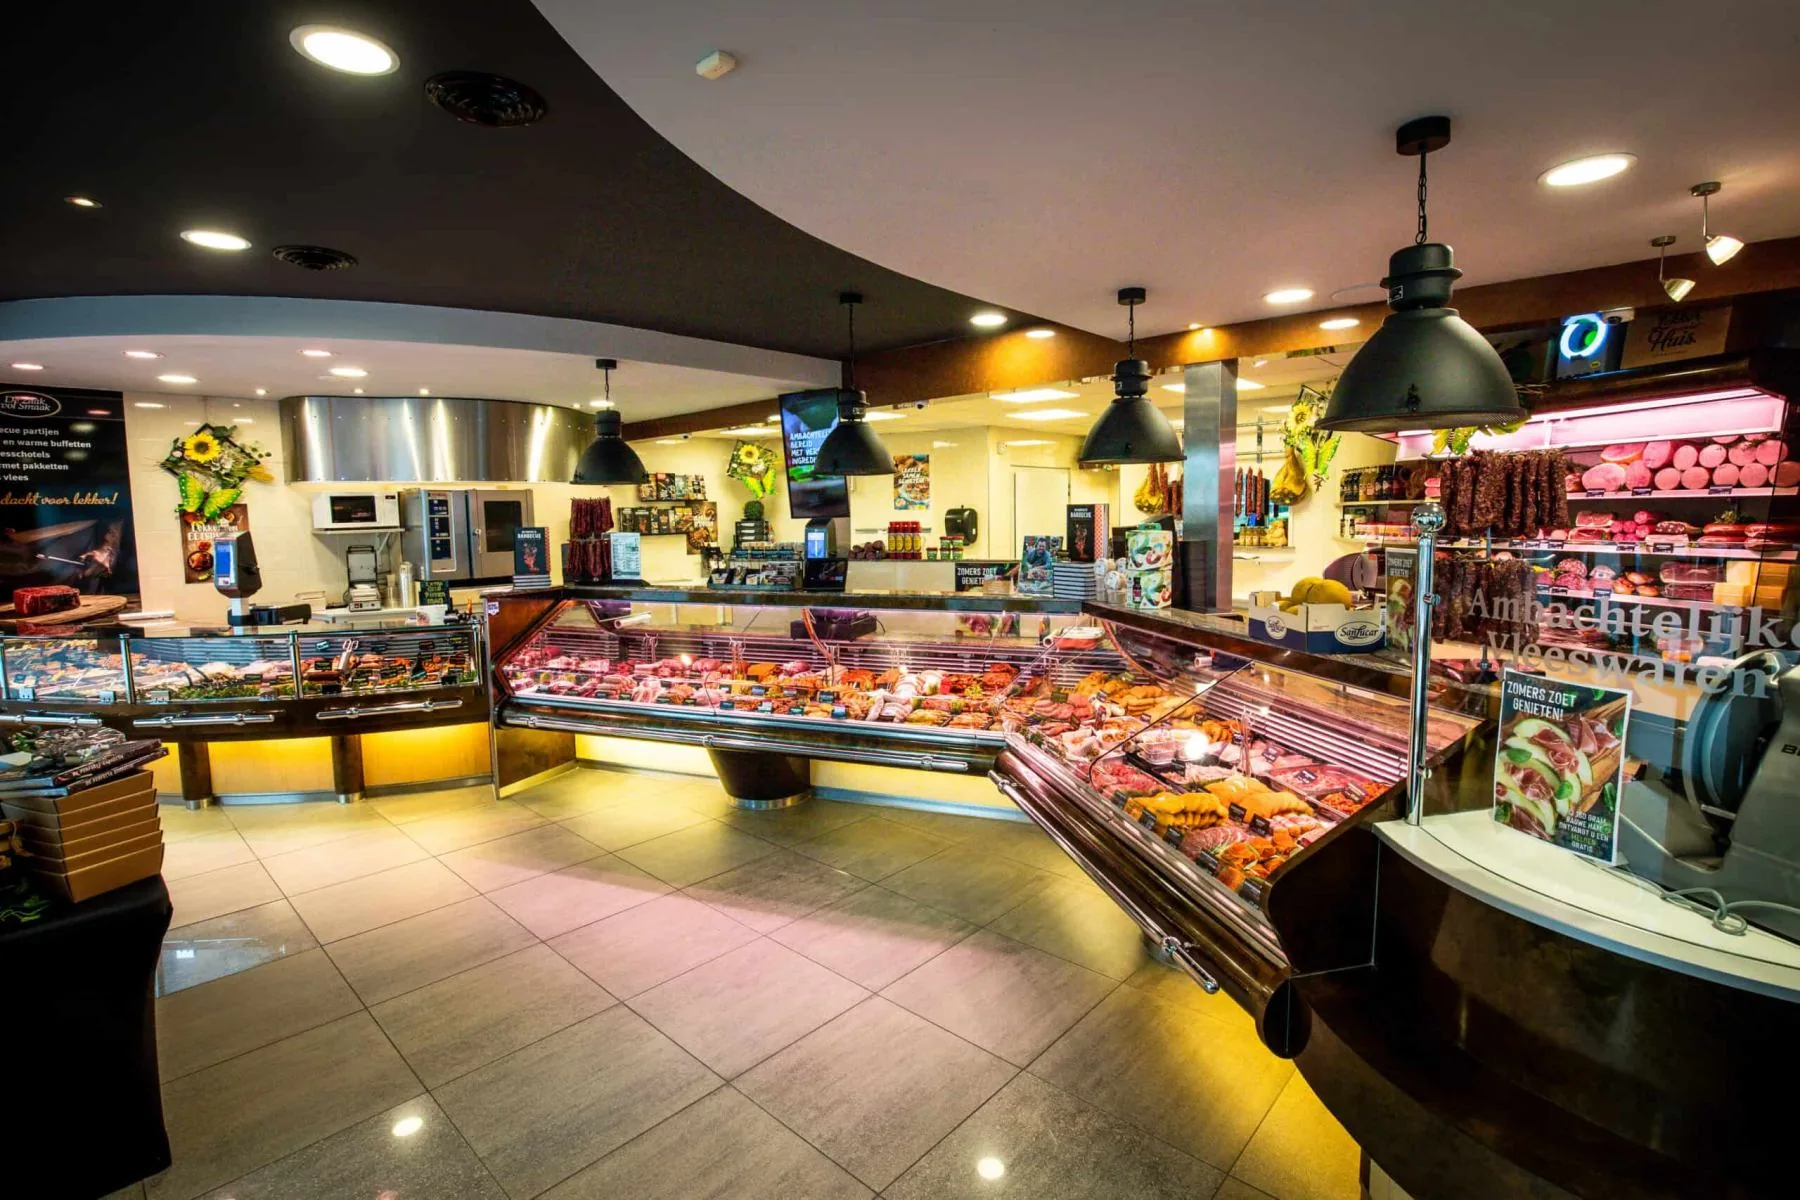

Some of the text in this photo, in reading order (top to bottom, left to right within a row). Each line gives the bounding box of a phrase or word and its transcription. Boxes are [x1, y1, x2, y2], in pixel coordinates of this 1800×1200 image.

[22, 427, 59, 437] partijen
[50, 440, 92, 448] buffetten
[791, 449, 803, 457] MET
[22, 462, 69, 471] pakketten
[41, 495, 69, 505] voor
[72, 492, 119, 505] lekker!
[957, 567, 998, 576] ZOMERS ZOET
[1486, 630, 1770, 699] Vleeswaren
[1507, 681, 1577, 708] ZOMERS ZOET
[1512, 697, 1564, 720] GENIETEN!
